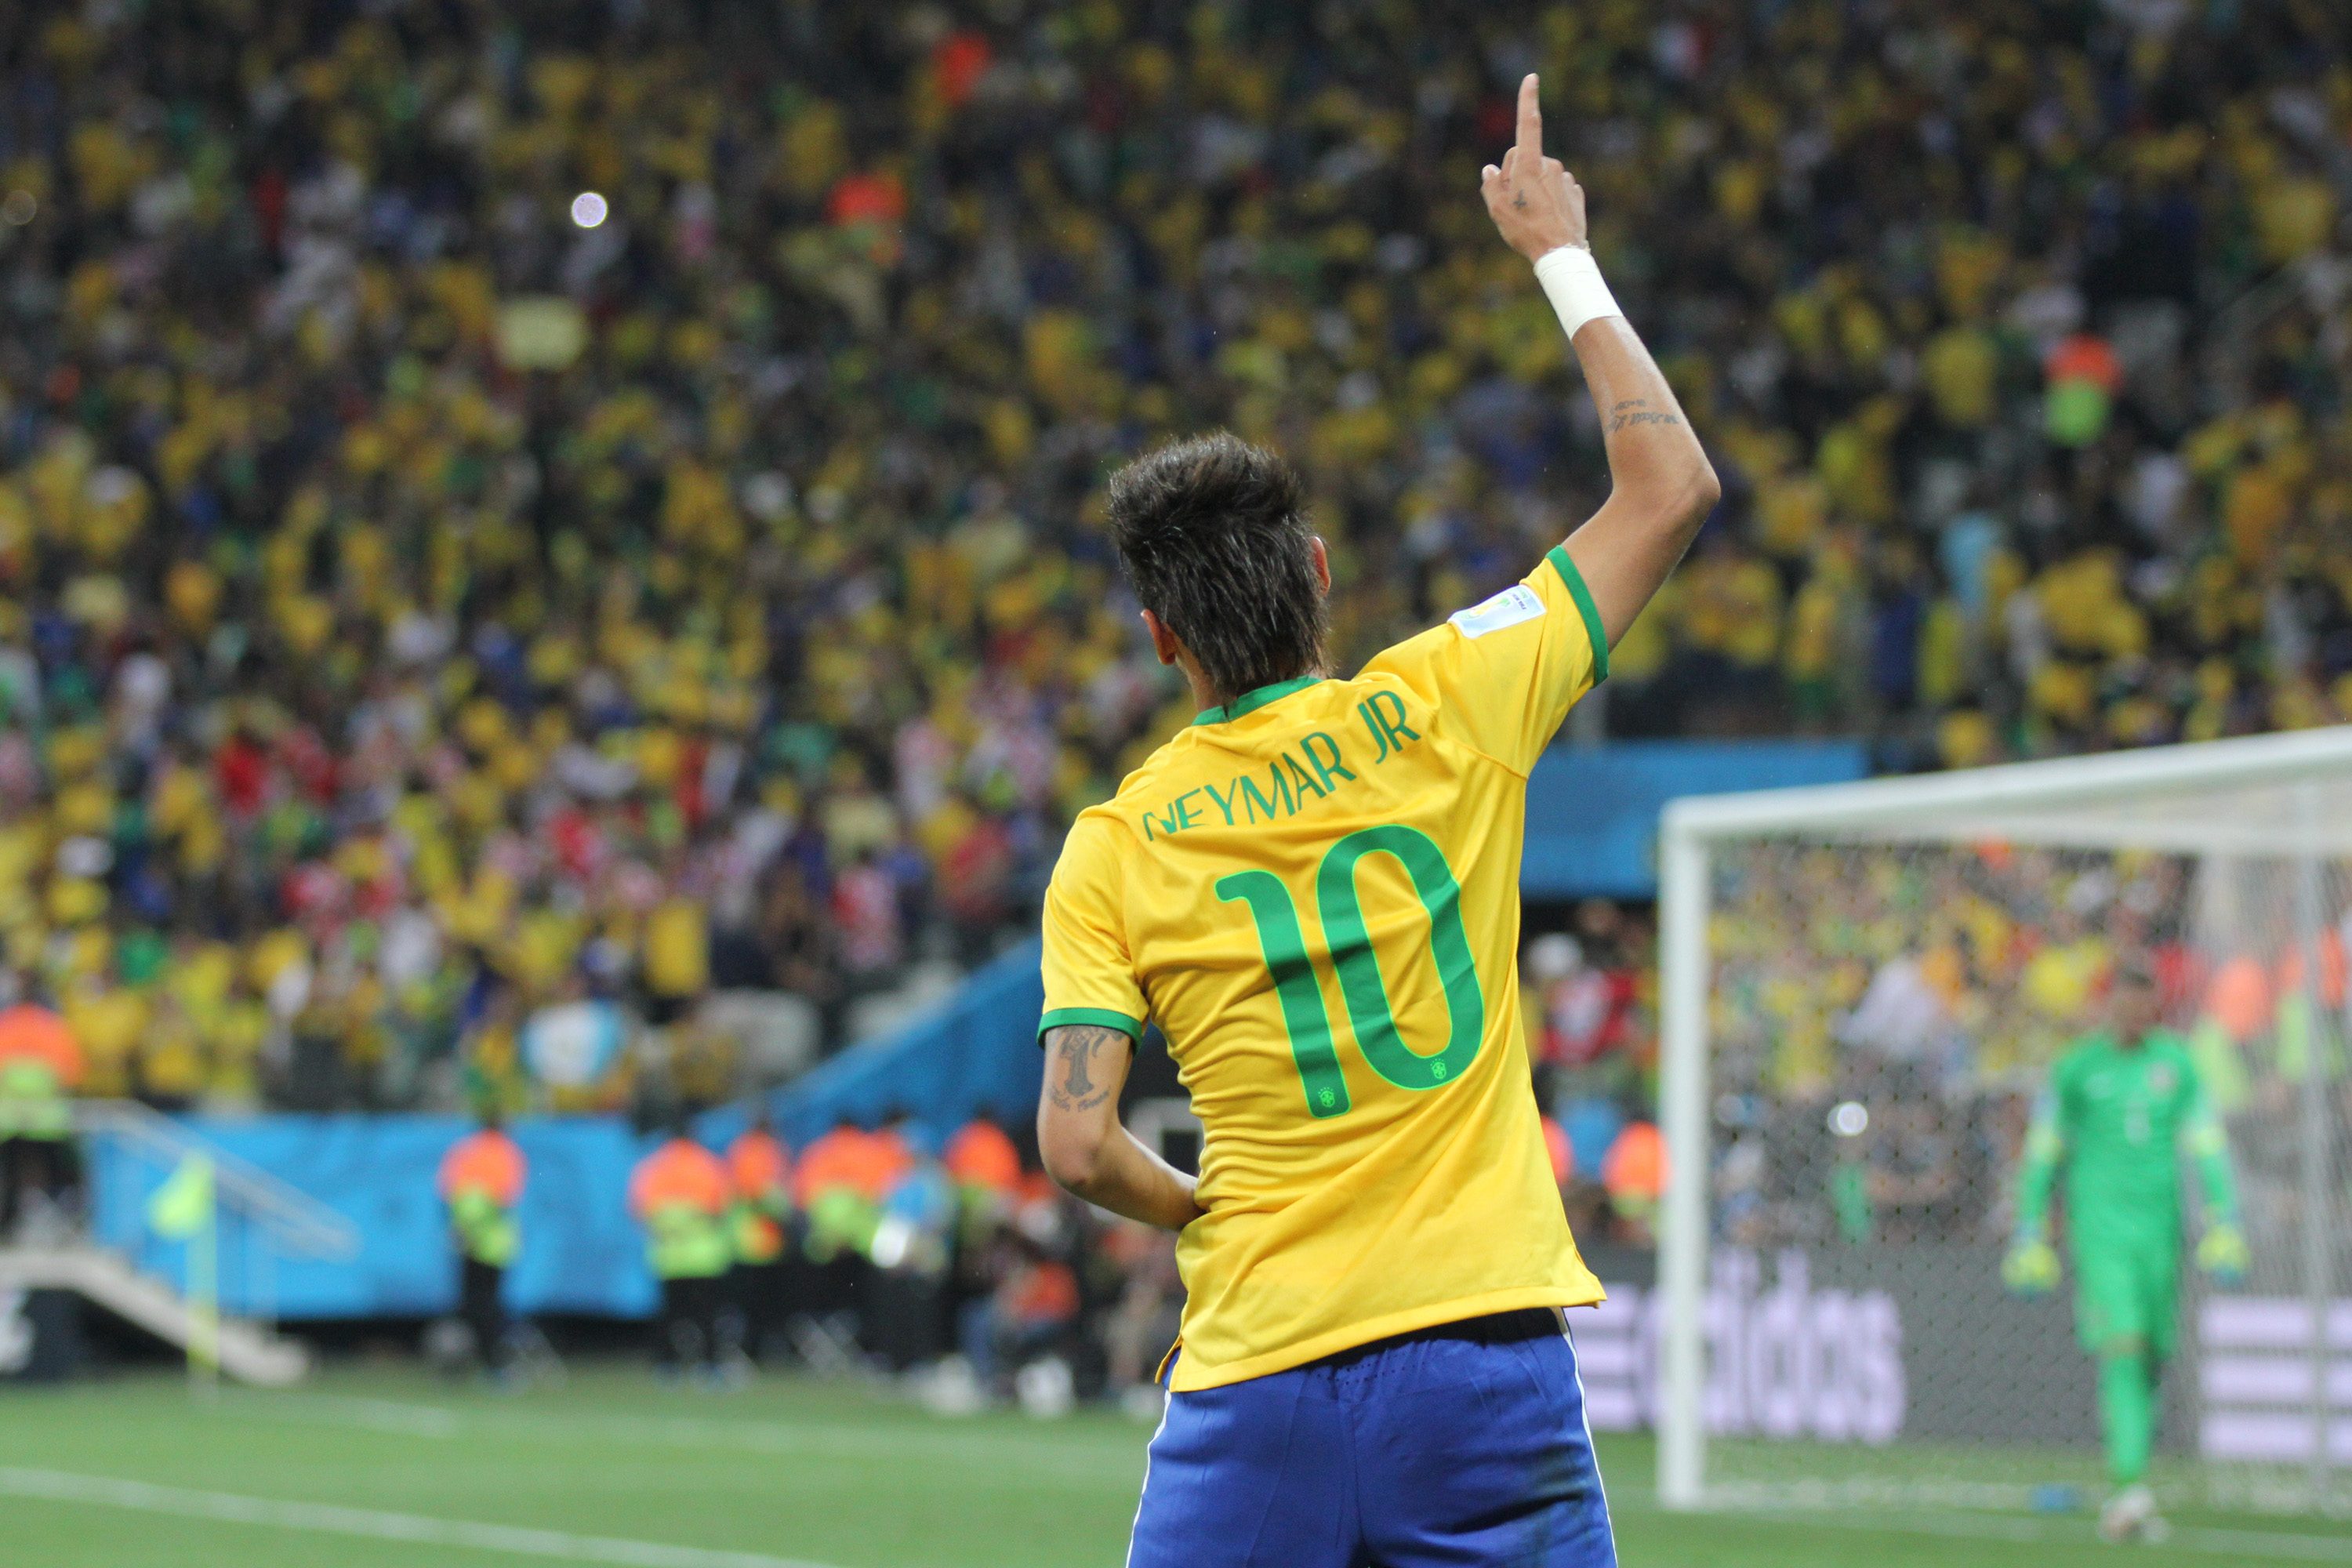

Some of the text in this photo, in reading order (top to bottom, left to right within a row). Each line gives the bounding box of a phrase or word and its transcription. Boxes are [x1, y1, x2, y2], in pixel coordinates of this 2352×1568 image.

[1142, 690, 1421, 842] NEYMAR JR
[1214, 824, 1485, 1120] 10
